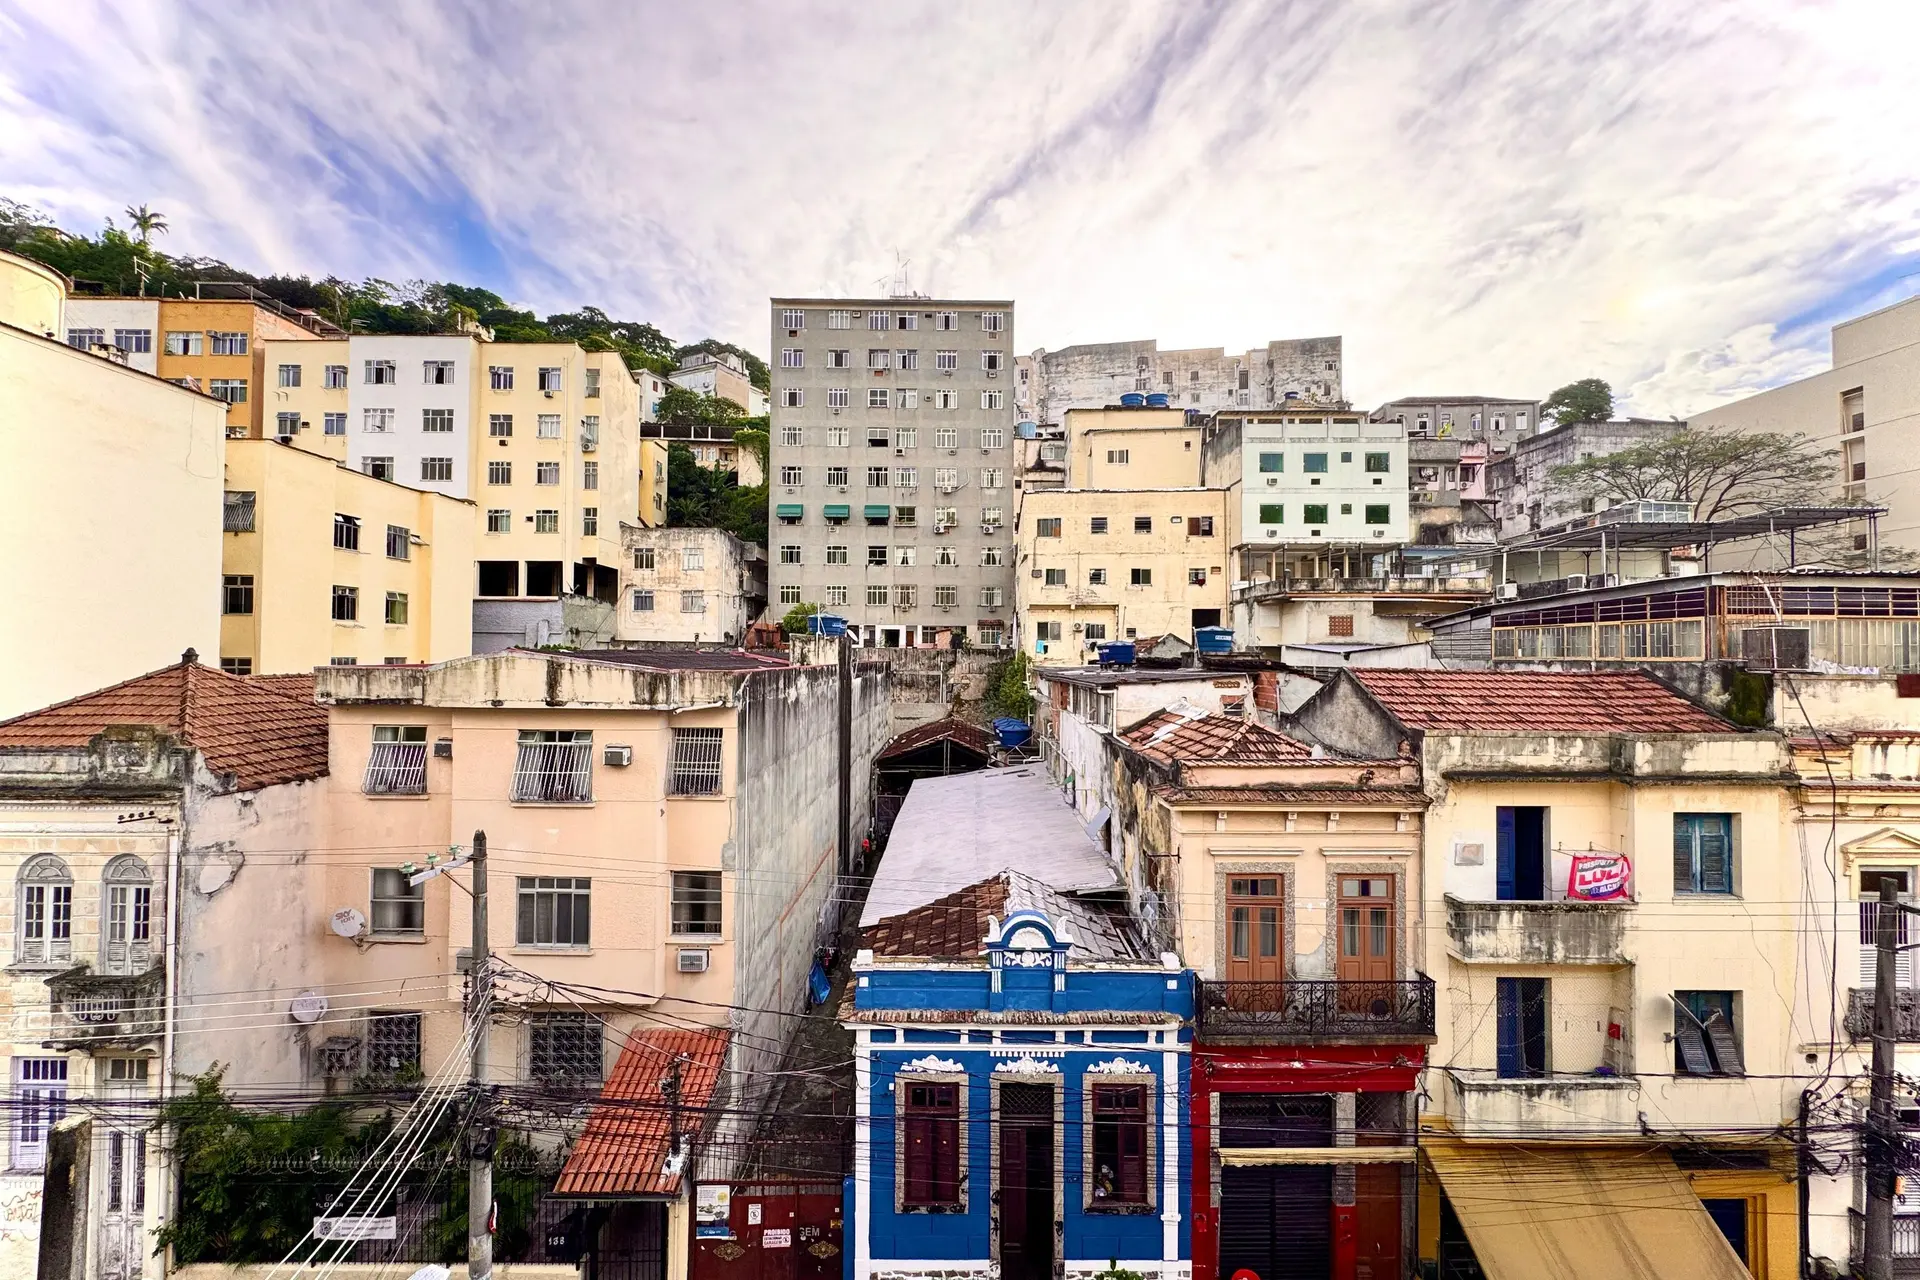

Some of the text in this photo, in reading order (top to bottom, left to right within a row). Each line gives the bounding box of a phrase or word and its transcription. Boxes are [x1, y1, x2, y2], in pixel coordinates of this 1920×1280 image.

[1578, 868, 1622, 886] LUL
[335, 909, 351, 920] SKY
[763, 1228, 790, 1236] PROIBIDO
